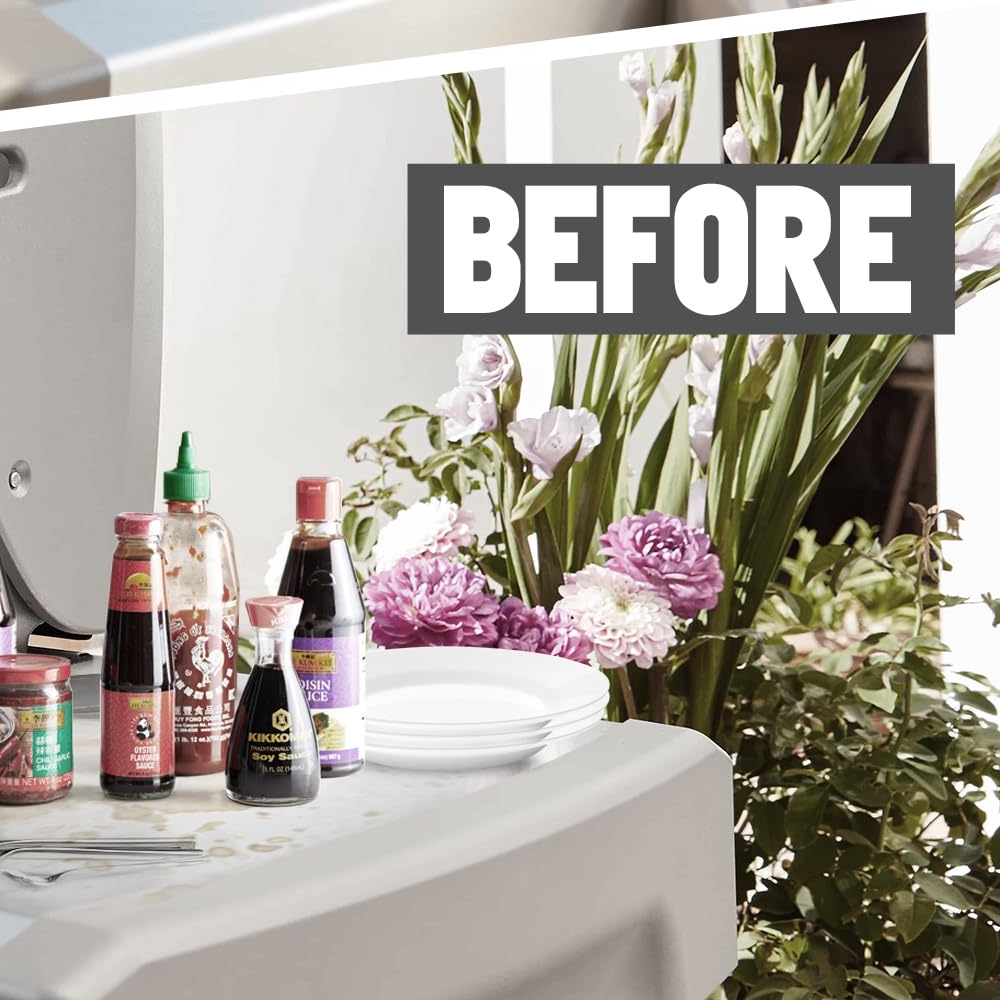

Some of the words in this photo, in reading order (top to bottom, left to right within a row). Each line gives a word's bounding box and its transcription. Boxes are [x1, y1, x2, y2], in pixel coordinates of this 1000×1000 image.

[301, 679, 331, 691] OISIN
[248, 729, 312, 743] KIKKOM
[252, 752, 275, 763] Soy
[135, 761, 155, 770] SAUCE
